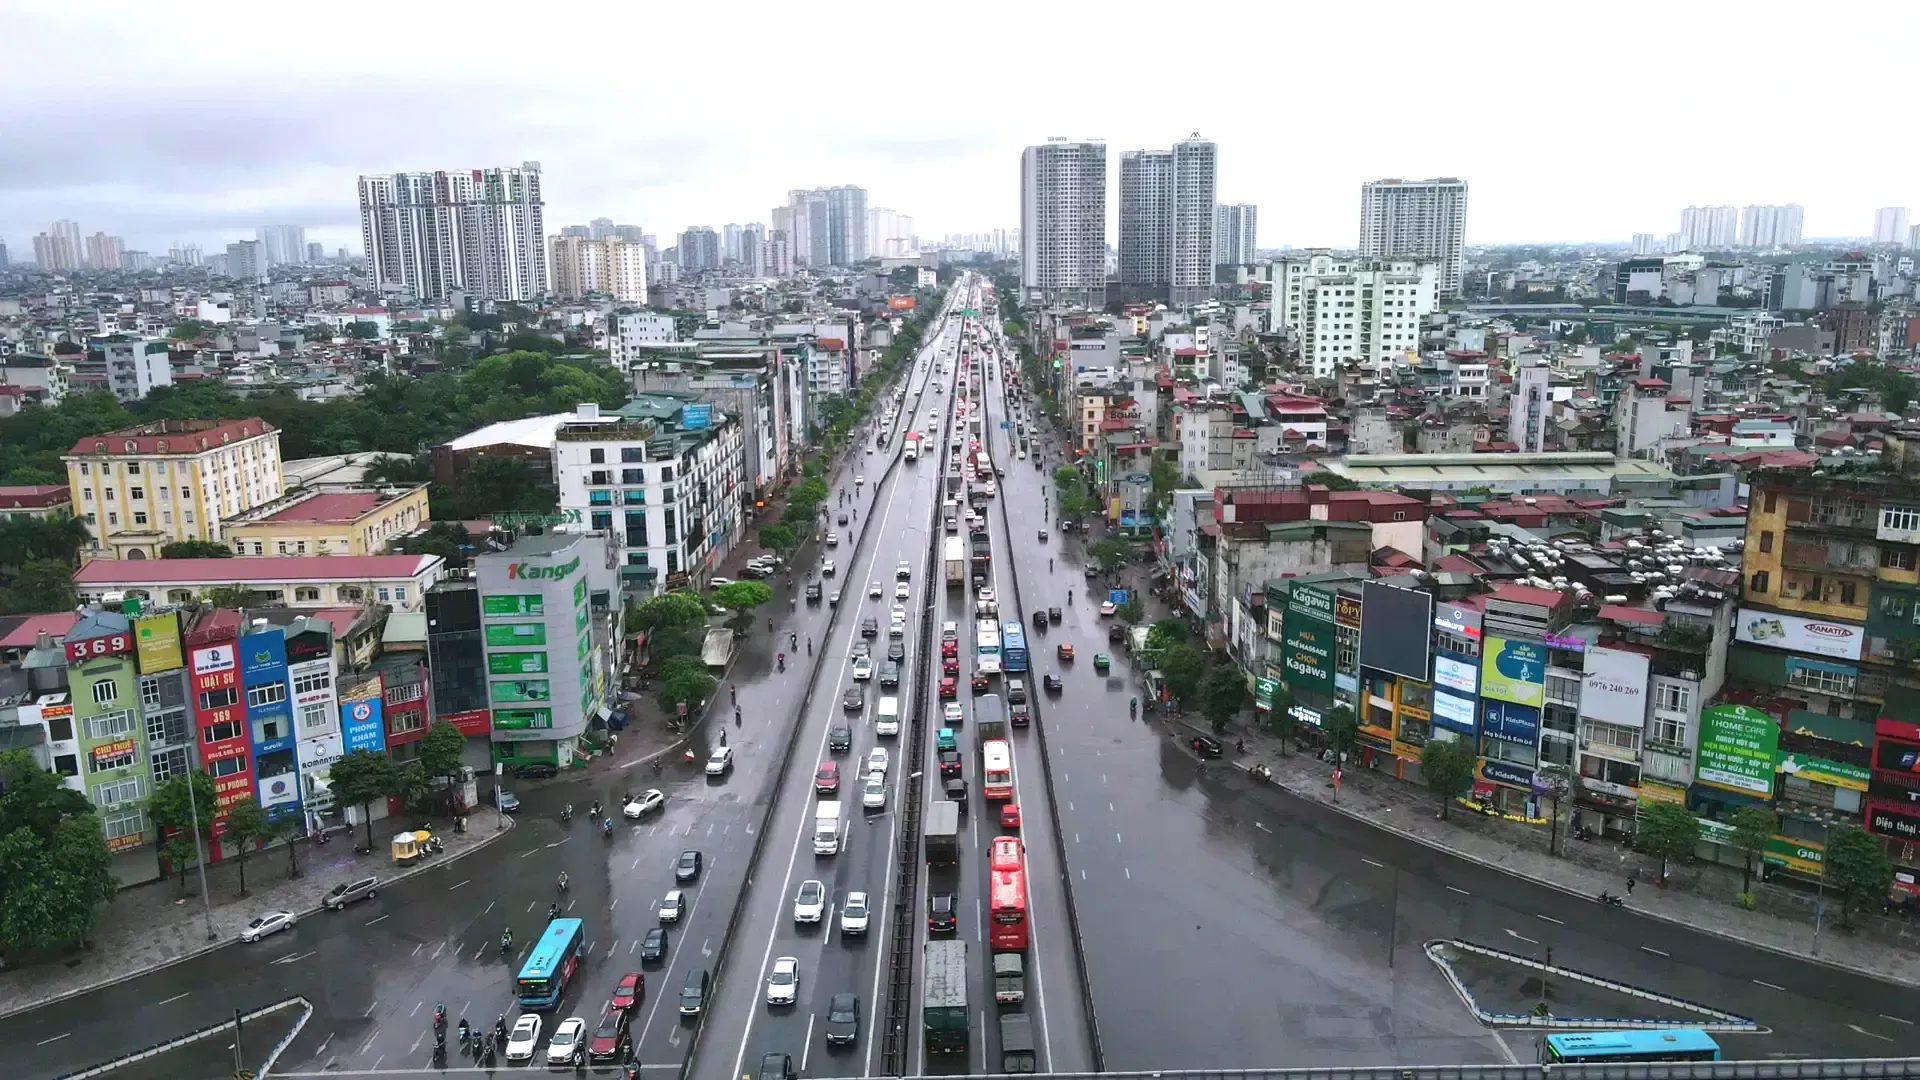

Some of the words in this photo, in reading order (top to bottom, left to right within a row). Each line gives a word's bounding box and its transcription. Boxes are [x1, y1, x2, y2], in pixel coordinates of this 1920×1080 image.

[1293, 589, 1330, 610] Kagawa
[1286, 656, 1327, 679] Kagawa
[200, 674, 219, 690] LUẬT
[223, 670, 235, 684] SƯ
[1589, 680, 1607, 690] 0976
[1609, 683, 1623, 693] 240
[1624, 686, 1639, 696] 269
[212, 709, 231, 723] 369
[1287, 706, 1321, 726] Kagawa
[1505, 716, 1536, 728] KidsPlaza
[349, 721, 378, 734] PHÒNG
[1715, 720, 1744, 732] HOME
[1744, 725, 1767, 736] CARE
[227, 778, 248, 790] PHÒNG
[1495, 771, 1530, 785] KidsPlaza
[1875, 816, 1893, 831] Điện
[1896, 821, 1917, 837] thoại
